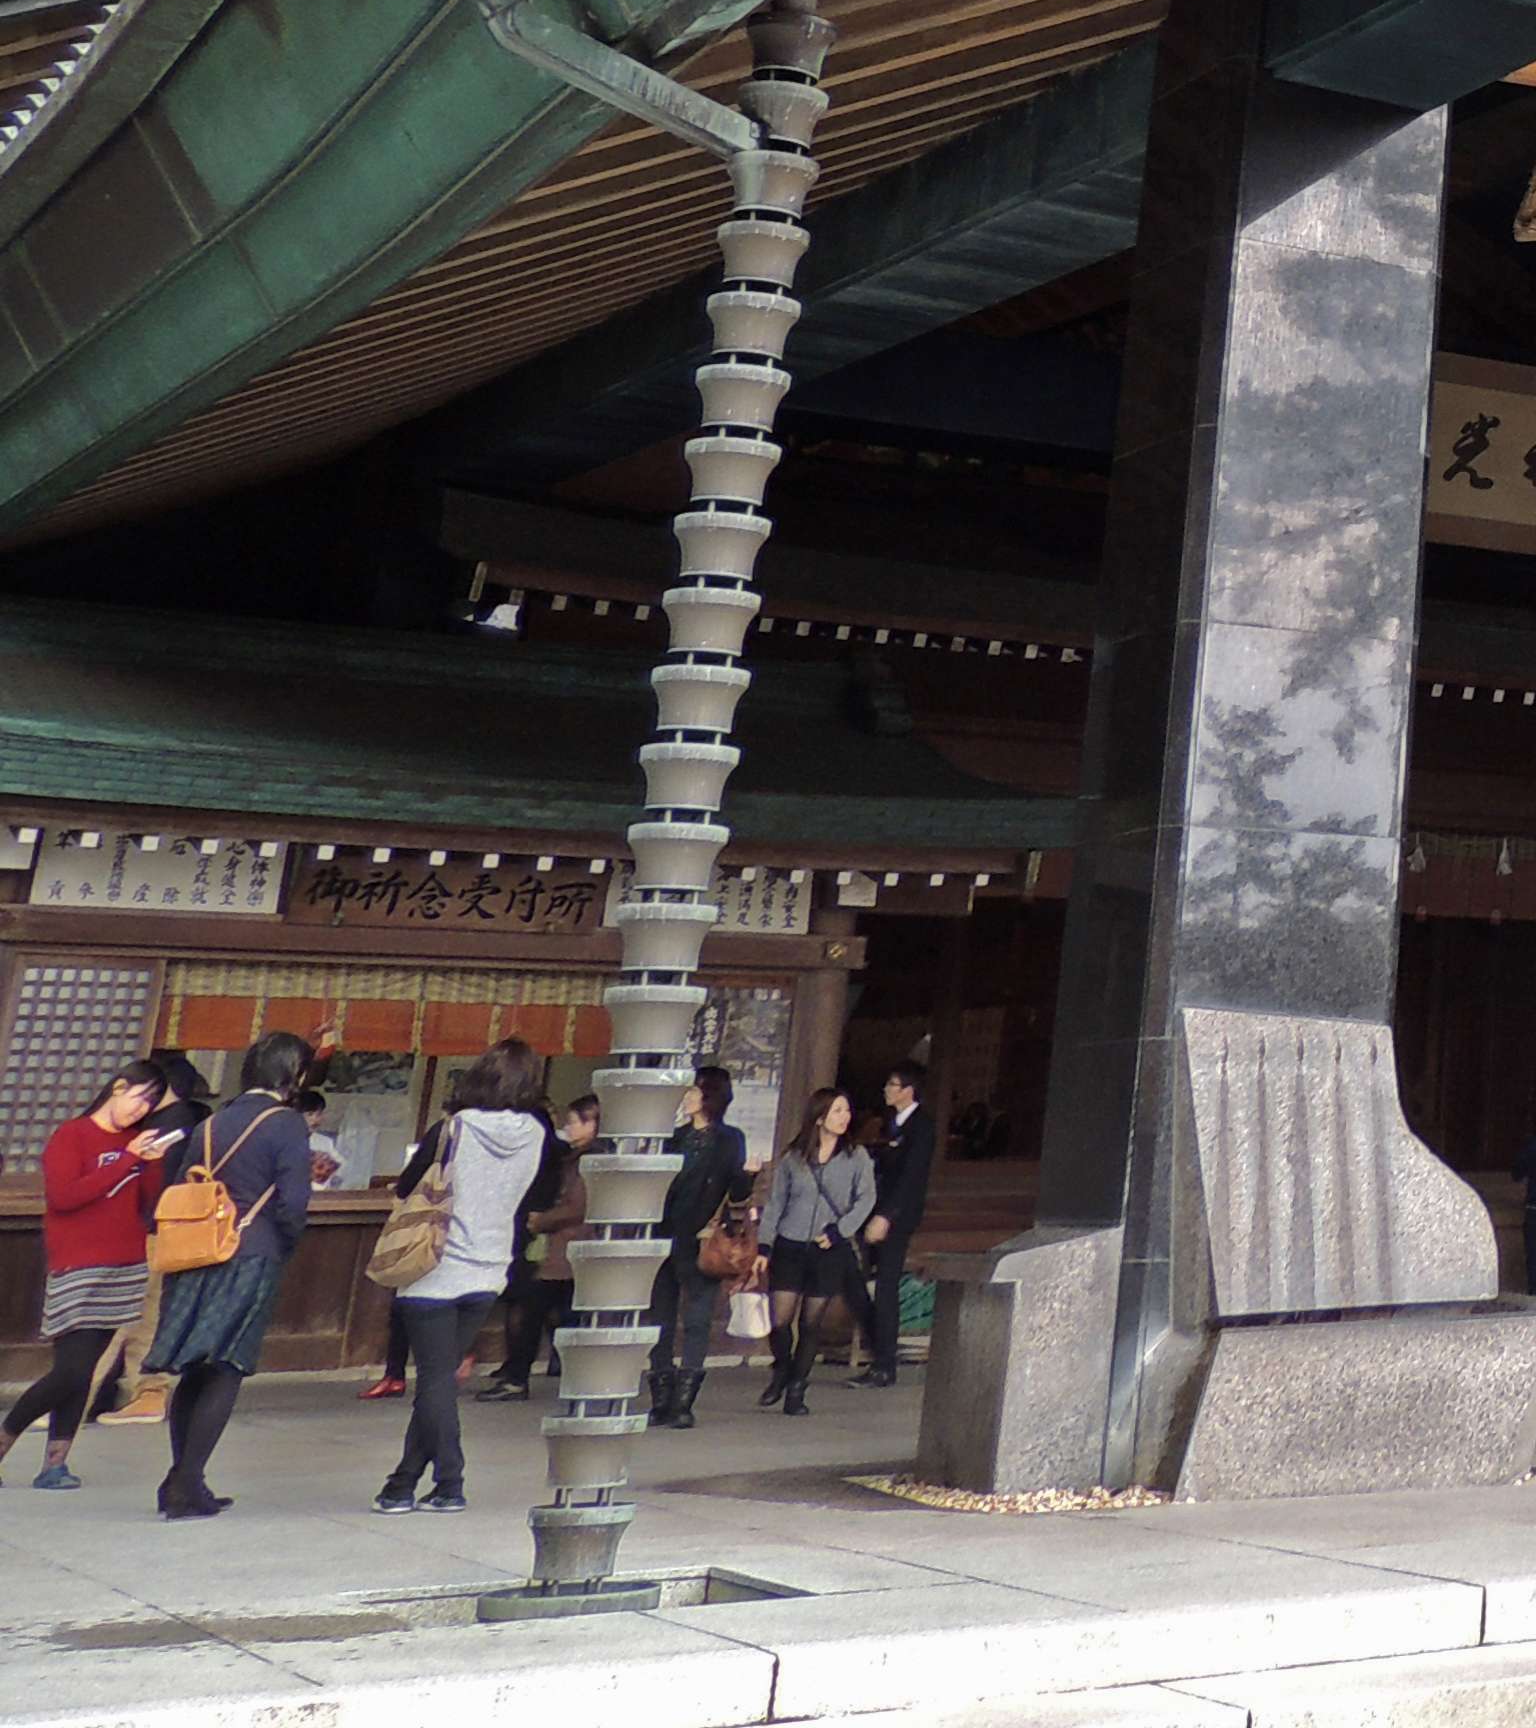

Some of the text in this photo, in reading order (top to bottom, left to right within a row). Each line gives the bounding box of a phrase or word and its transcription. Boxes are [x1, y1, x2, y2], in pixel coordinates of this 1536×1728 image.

[306, 865, 597, 925] 御祈念受付所
